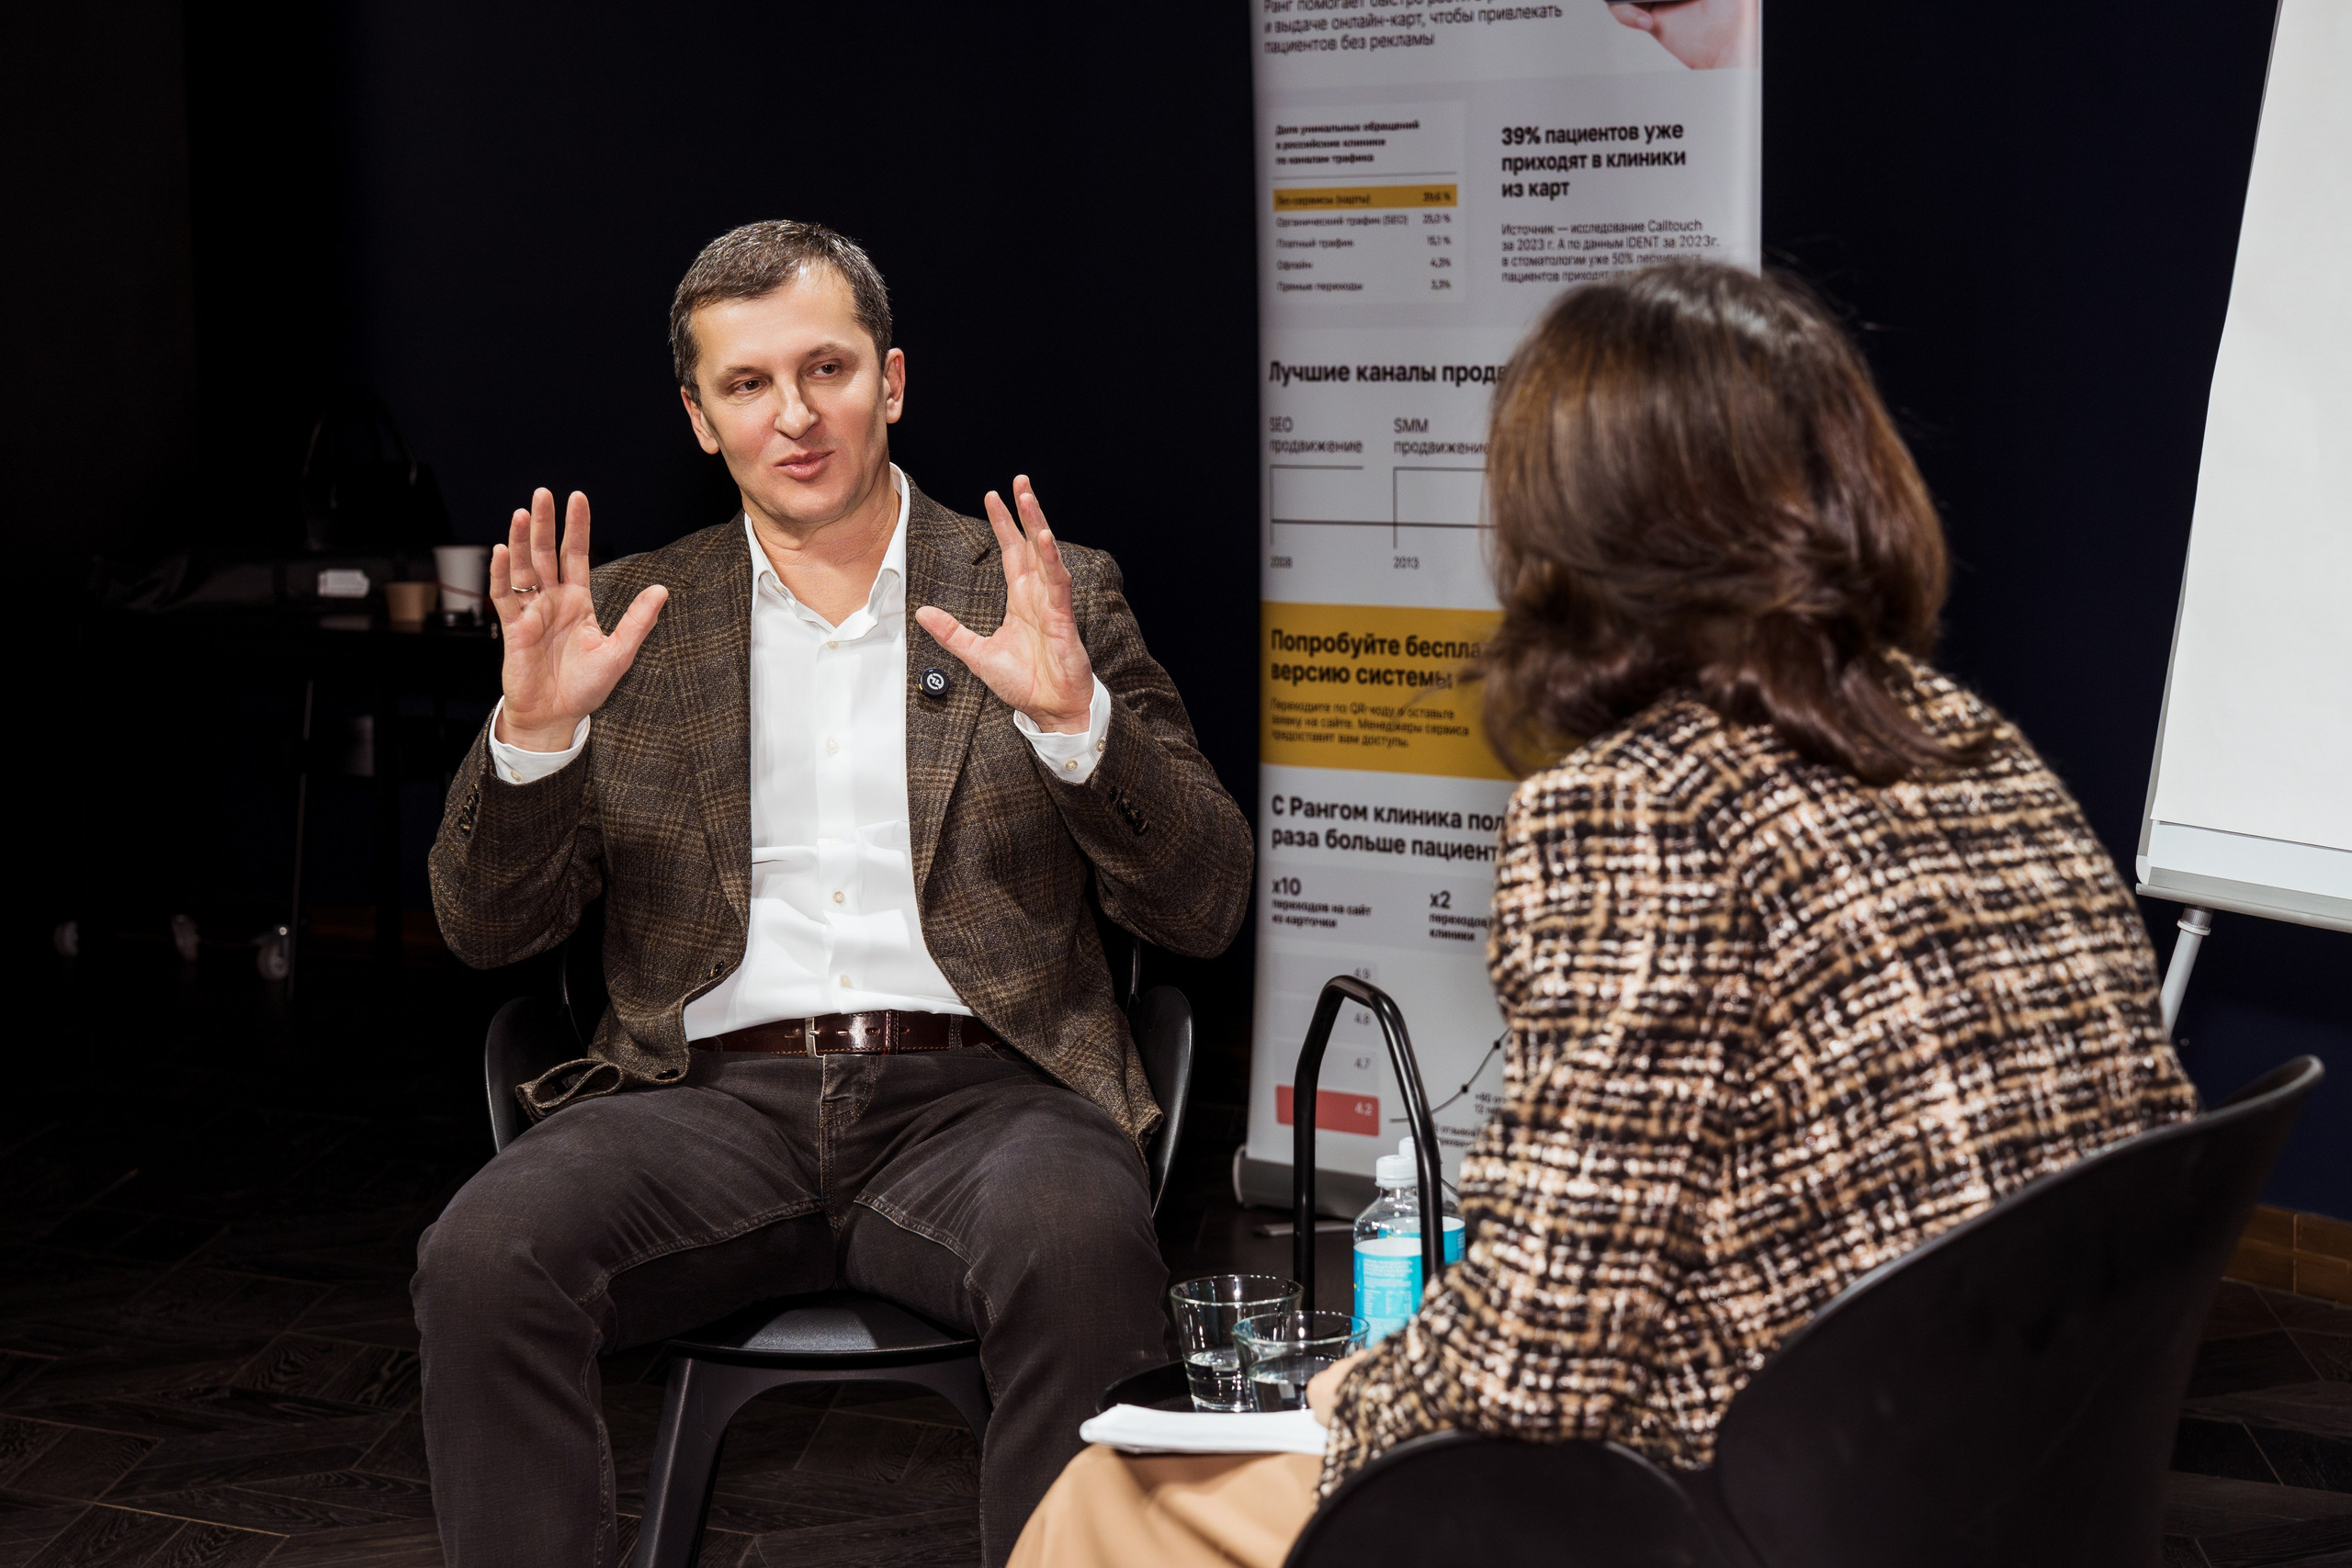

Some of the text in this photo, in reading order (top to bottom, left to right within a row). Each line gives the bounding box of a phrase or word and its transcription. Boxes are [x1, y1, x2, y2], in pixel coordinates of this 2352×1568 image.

[1274, 18, 1329, 34] выдаче
[1430, 7, 1475, 24] чтобы
[1478, 5, 1563, 26] привлекать
[1264, 33, 1435, 55] пациентов без рекламы
[1501, 123, 1684, 145] 39% пациентов уже
[1501, 151, 1686, 175] приходят в клиники
[1501, 181, 1570, 201] из карт
[1501, 223, 1555, 236] Источник
[1570, 221, 1645, 235] исследование
[1647, 219, 1703, 232] Calltouch
[1501, 240, 1514, 253] за
[1517, 238, 1544, 252] 2023
[1567, 240, 1581, 250] по
[1582, 238, 1623, 252] данным
[1625, 235, 1659, 249] IDENT
[1662, 237, 1675, 248] за
[1501, 257, 1509, 267] в
[1510, 254, 1586, 267] стоматологии
[1589, 254, 1608, 268] уже
[1611, 252, 1634, 265] 50%
[1501, 271, 1560, 284] пациентов
[1269, 360, 1351, 387] Лучшие
[1355, 364, 1436, 382] каналы
[1270, 416, 1294, 433] SEO
[1393, 417, 1430, 434] SMM
[1270, 439, 1363, 455] продвижение
[1272, 628, 1481, 660] Попробуйте беспла
[1272, 662, 1453, 689] версию системы
[1272, 794, 1506, 831] С Рангом клиника пол
[1272, 828, 1498, 862] раза больше пациент
